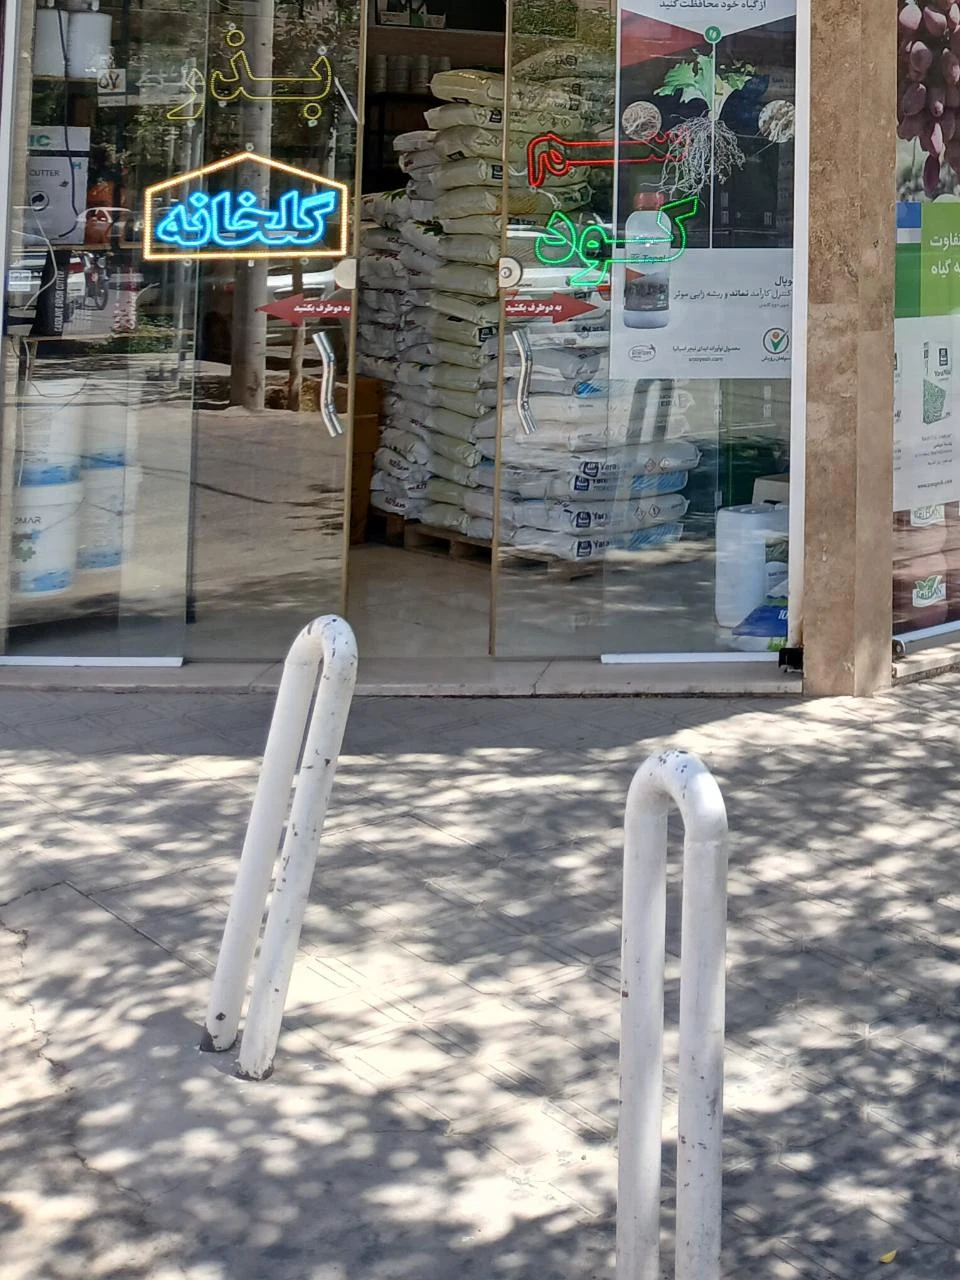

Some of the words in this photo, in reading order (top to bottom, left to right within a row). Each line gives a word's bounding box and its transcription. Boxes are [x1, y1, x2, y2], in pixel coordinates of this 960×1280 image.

[660, 0, 679, 9] کنید
[720, 0, 739, 10] خود
[166, 29, 333, 120] بذر
[153, 189, 336, 246] گلخانه
[931, 258, 952, 278] گیاه
